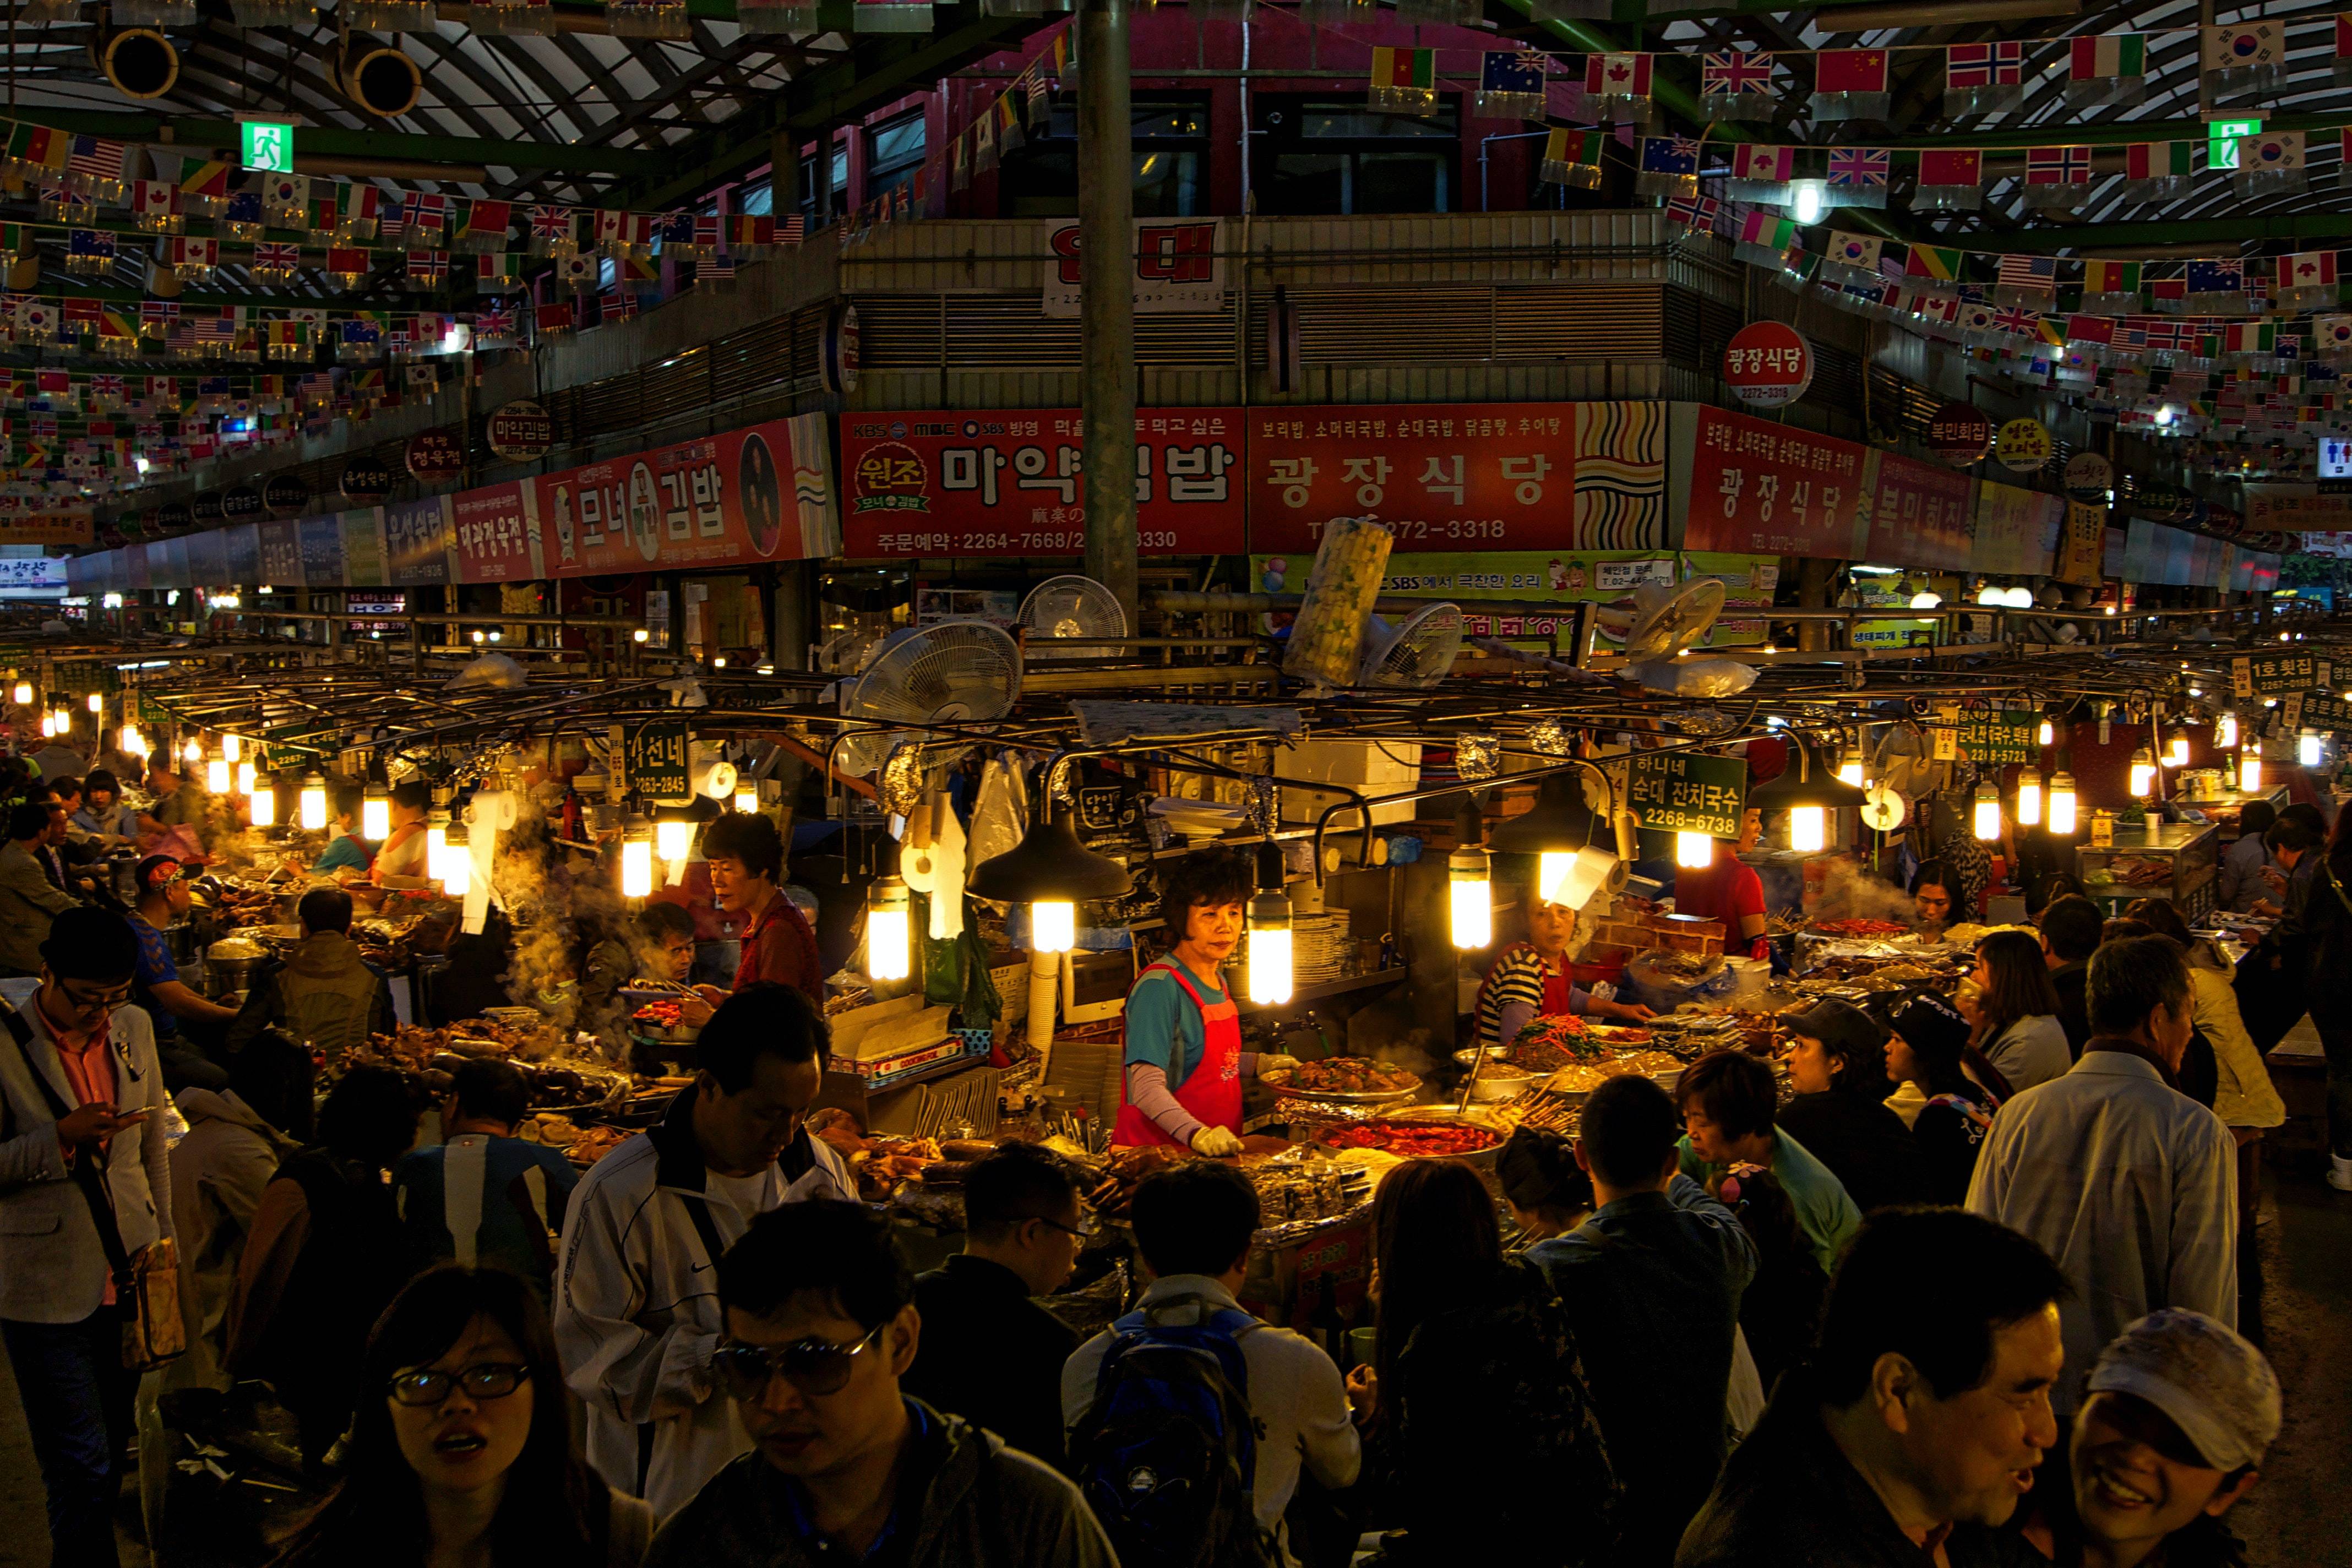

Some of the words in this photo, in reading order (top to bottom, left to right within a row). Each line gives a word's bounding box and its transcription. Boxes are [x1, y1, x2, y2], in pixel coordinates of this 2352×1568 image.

[1728, 347, 1802, 374] 광장식당
[497, 420, 551, 440] 마약김밥
[853, 423, 888, 439] KBS
[913, 423, 956, 437] MBC
[982, 423, 1005, 435] SBS
[1009, 421, 1039, 437] 방영
[1152, 418, 1185, 435] 먹고
[1191, 417, 1226, 435] 싶은
[1518, 417, 1561, 436] 추어탕
[1931, 422, 1986, 441] 복민회집
[412, 450, 461, 467] 정육점
[859, 457, 924, 489] 원조
[660, 464, 725, 540] 김밥
[1719, 467, 1842, 529] 광장식당
[1384, 520, 1506, 540] 272-3318
[1457, 574, 1505, 590] 극찬한
[1509, 574, 1541, 590] 요리
[1637, 755, 1686, 777] 하니네
[1970, 748, 2027, 763] 228-5723
[1632, 776, 1666, 805] 순대
[1672, 781, 1740, 814] 잔치국수
[1645, 807, 1735, 834] 2268-6738
